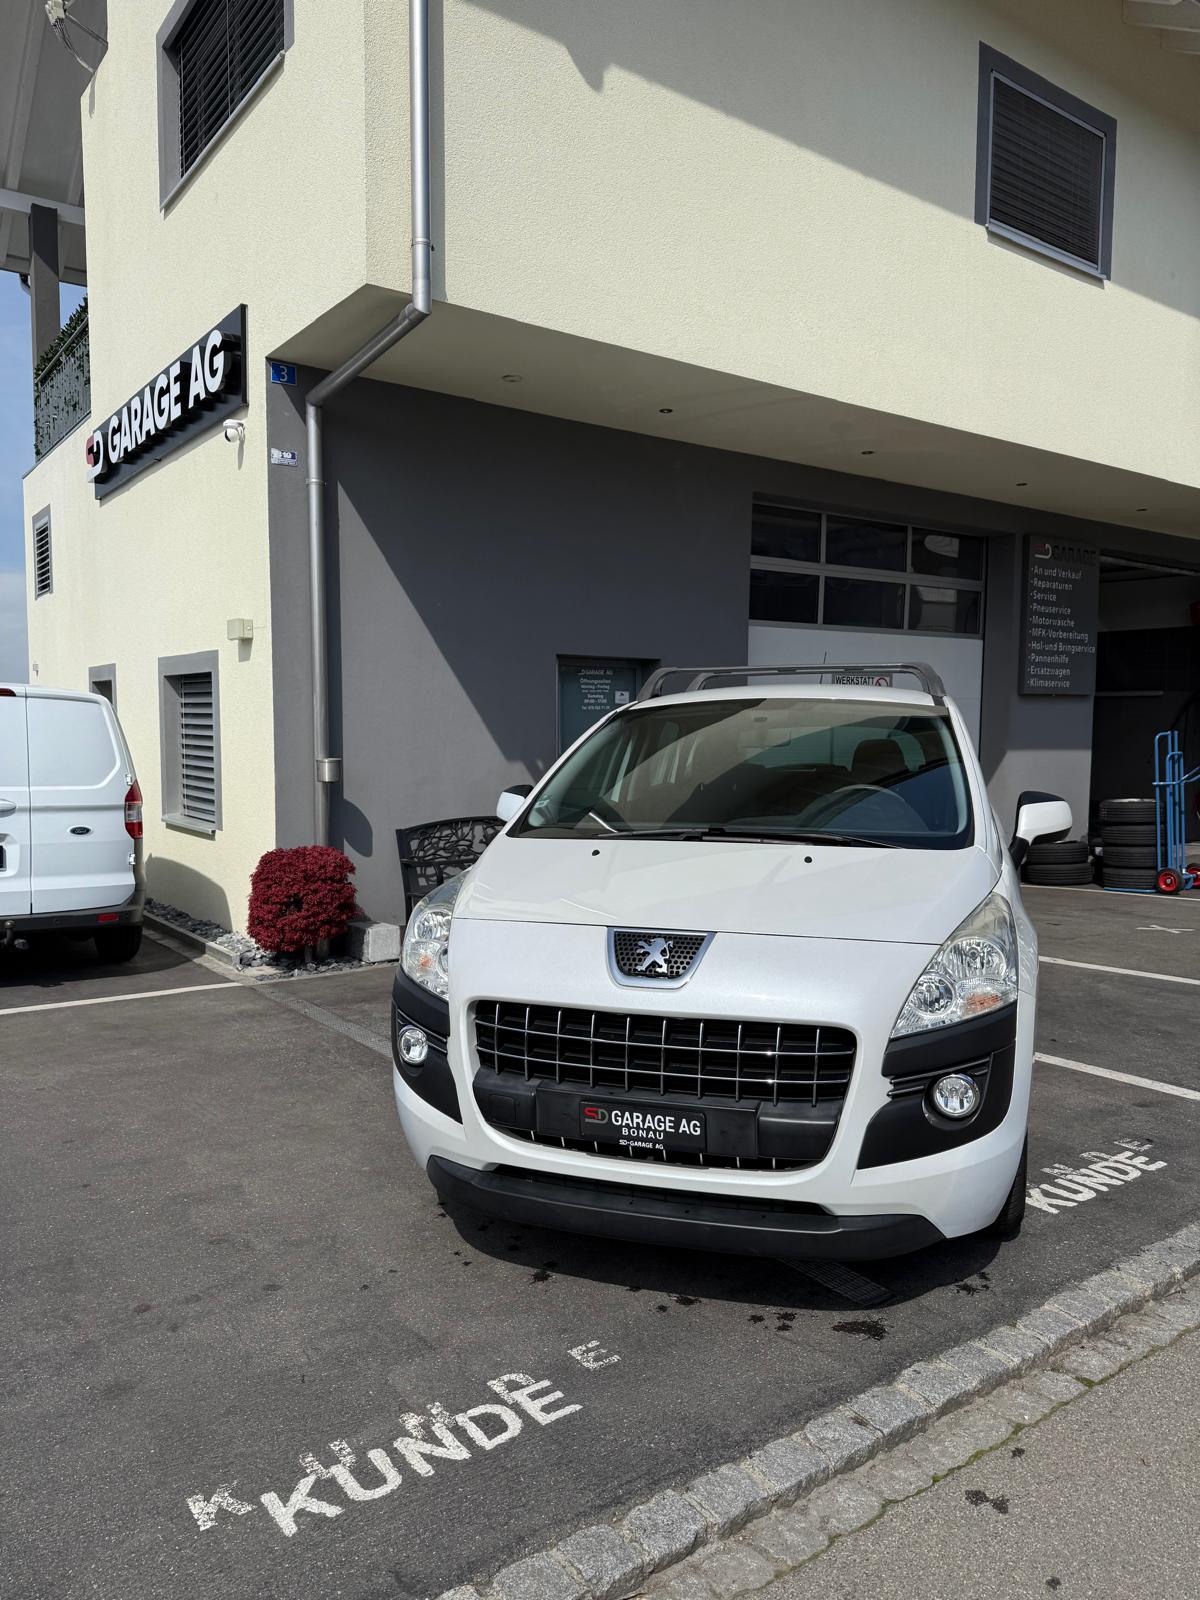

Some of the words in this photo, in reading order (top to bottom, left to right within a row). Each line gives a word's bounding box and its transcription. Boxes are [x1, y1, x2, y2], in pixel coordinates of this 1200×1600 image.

[279, 365, 288, 382] 3
[108, 361, 182, 463] GARAGE
[188, 329, 225, 409] AG
[1033, 565, 1043, 575] An
[1044, 567, 1057, 577] und
[1057, 568, 1082, 580] Verkauf
[1033, 577, 1073, 591] Reparaturen
[1032, 590, 1057, 602] Service
[1032, 602, 1071, 615] Pneuservice
[1031, 627, 1089, 643] MFK-Vorbereitung
[1058, 642, 1096, 655] Bringservice
[1030, 653, 1069, 664] Pannenhilfe
[1030, 665, 1071, 678] Ersatzwagen
[835, 675, 874, 686] WERKSTATT
[1029, 677, 1071, 688] Klimaservice
[583, 1107, 609, 1124] SD
[611, 1110, 675, 1133] GARAGE
[679, 1118, 701, 1136] AG
[622, 1127, 664, 1140] BONAU
[1025, 1151, 1168, 1214] KUNDE
[260, 1379, 584, 1538] KUNDE
